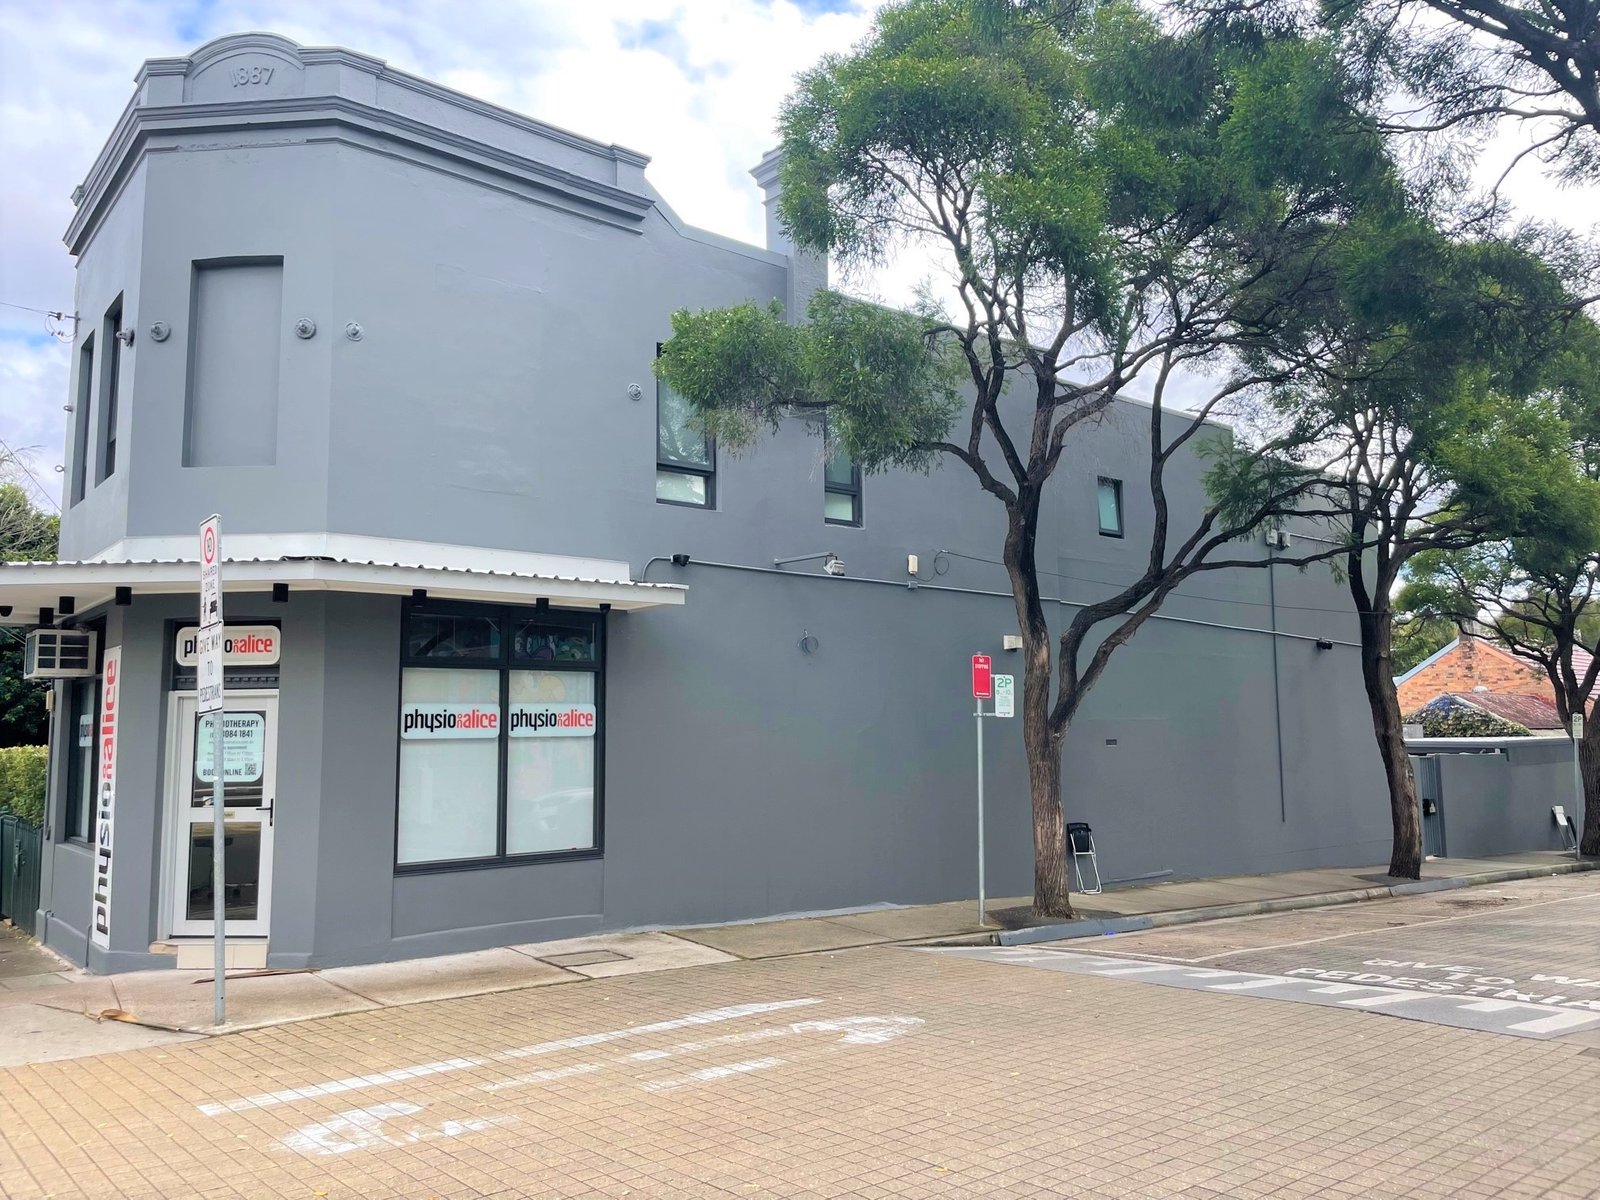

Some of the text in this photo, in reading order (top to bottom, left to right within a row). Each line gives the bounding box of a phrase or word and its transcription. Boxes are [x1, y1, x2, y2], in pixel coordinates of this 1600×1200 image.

[231, 67, 275, 88] 1887
[199, 636, 210, 655] GIVE
[212, 632, 222, 651] WAY
[207, 661, 214, 676] TO
[997, 678, 1012, 687] 2P
[239, 729, 253, 738] 1841
[1362, 957, 1485, 973] GIVE
[1445, 971, 1516, 984] TO
